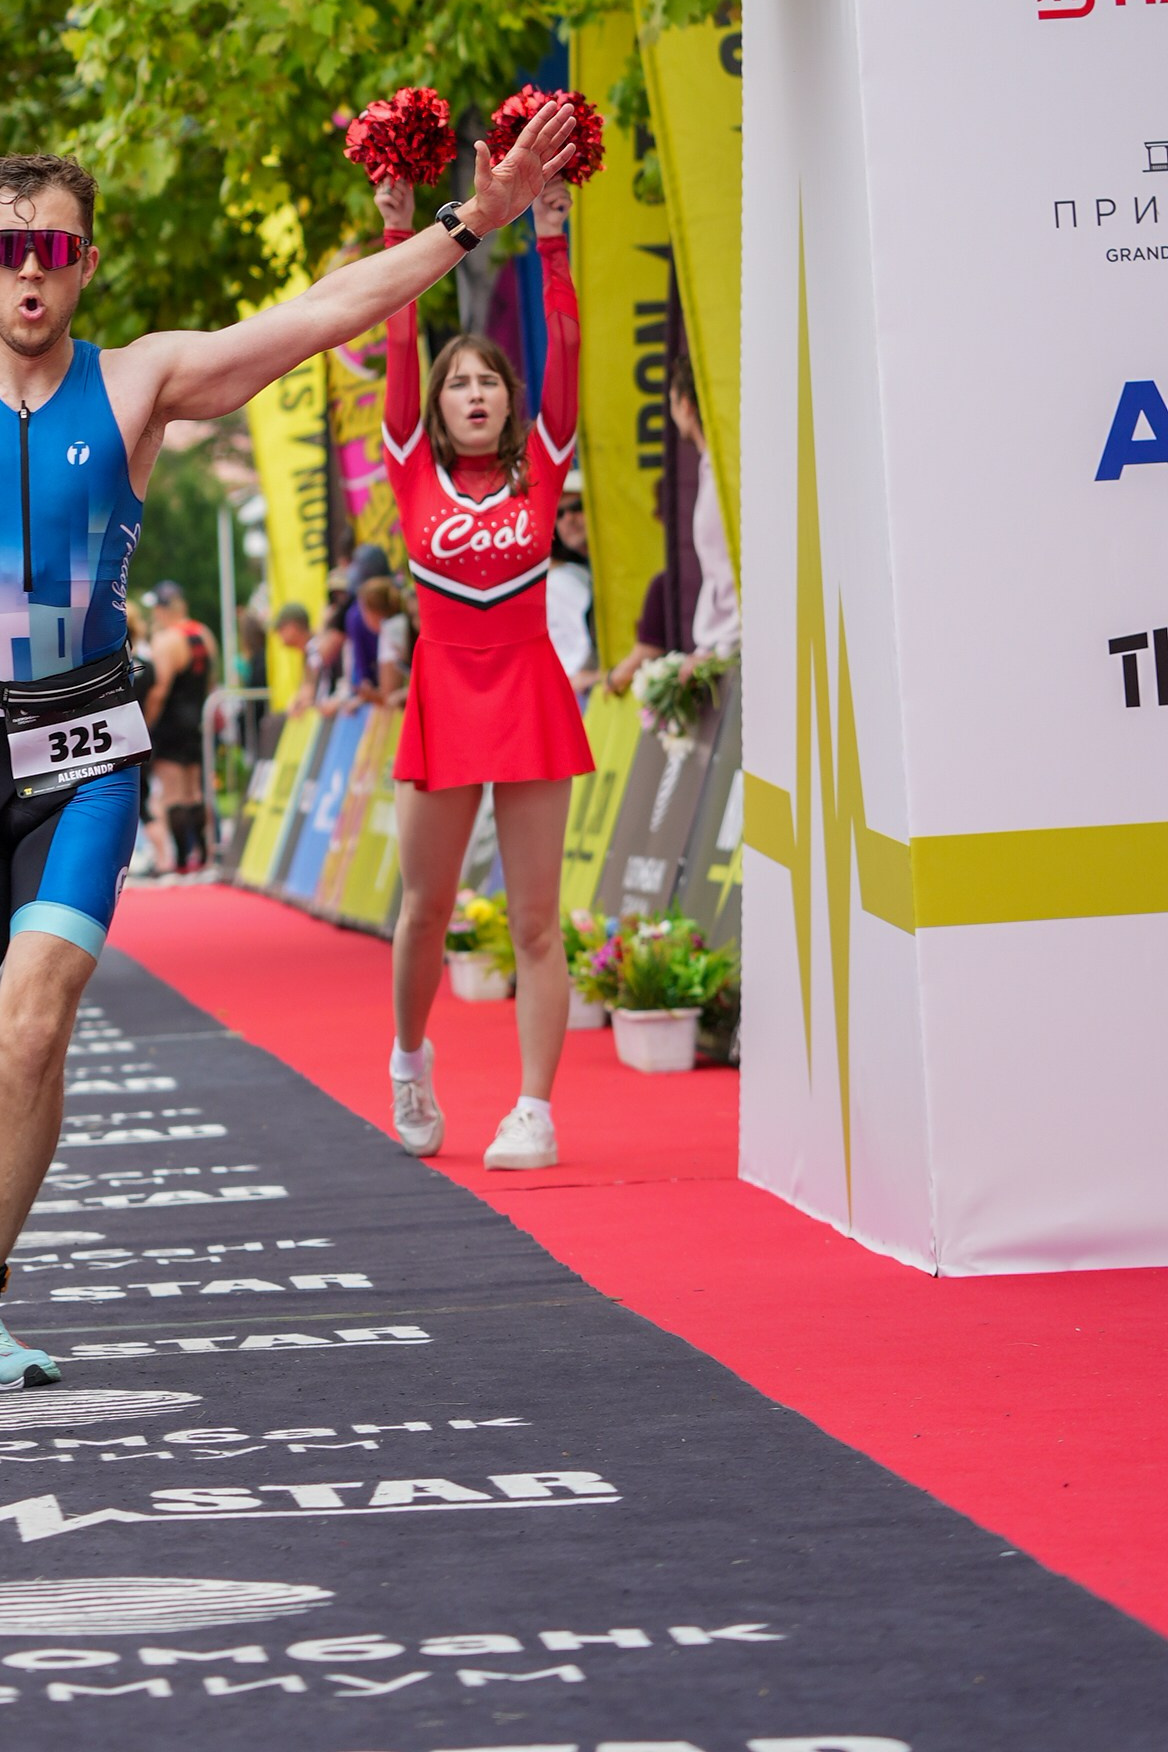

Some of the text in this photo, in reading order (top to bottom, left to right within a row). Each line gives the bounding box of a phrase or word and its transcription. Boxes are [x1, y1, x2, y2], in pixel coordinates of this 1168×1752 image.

[431, 509, 531, 558] Cool
[48, 720, 113, 763] 325
[58, 763, 115, 783] ALEKSANDR
[50, 1273, 375, 1302] STAR
[71, 1326, 431, 1356] STAR
[150, 1470, 621, 1511] STAR
